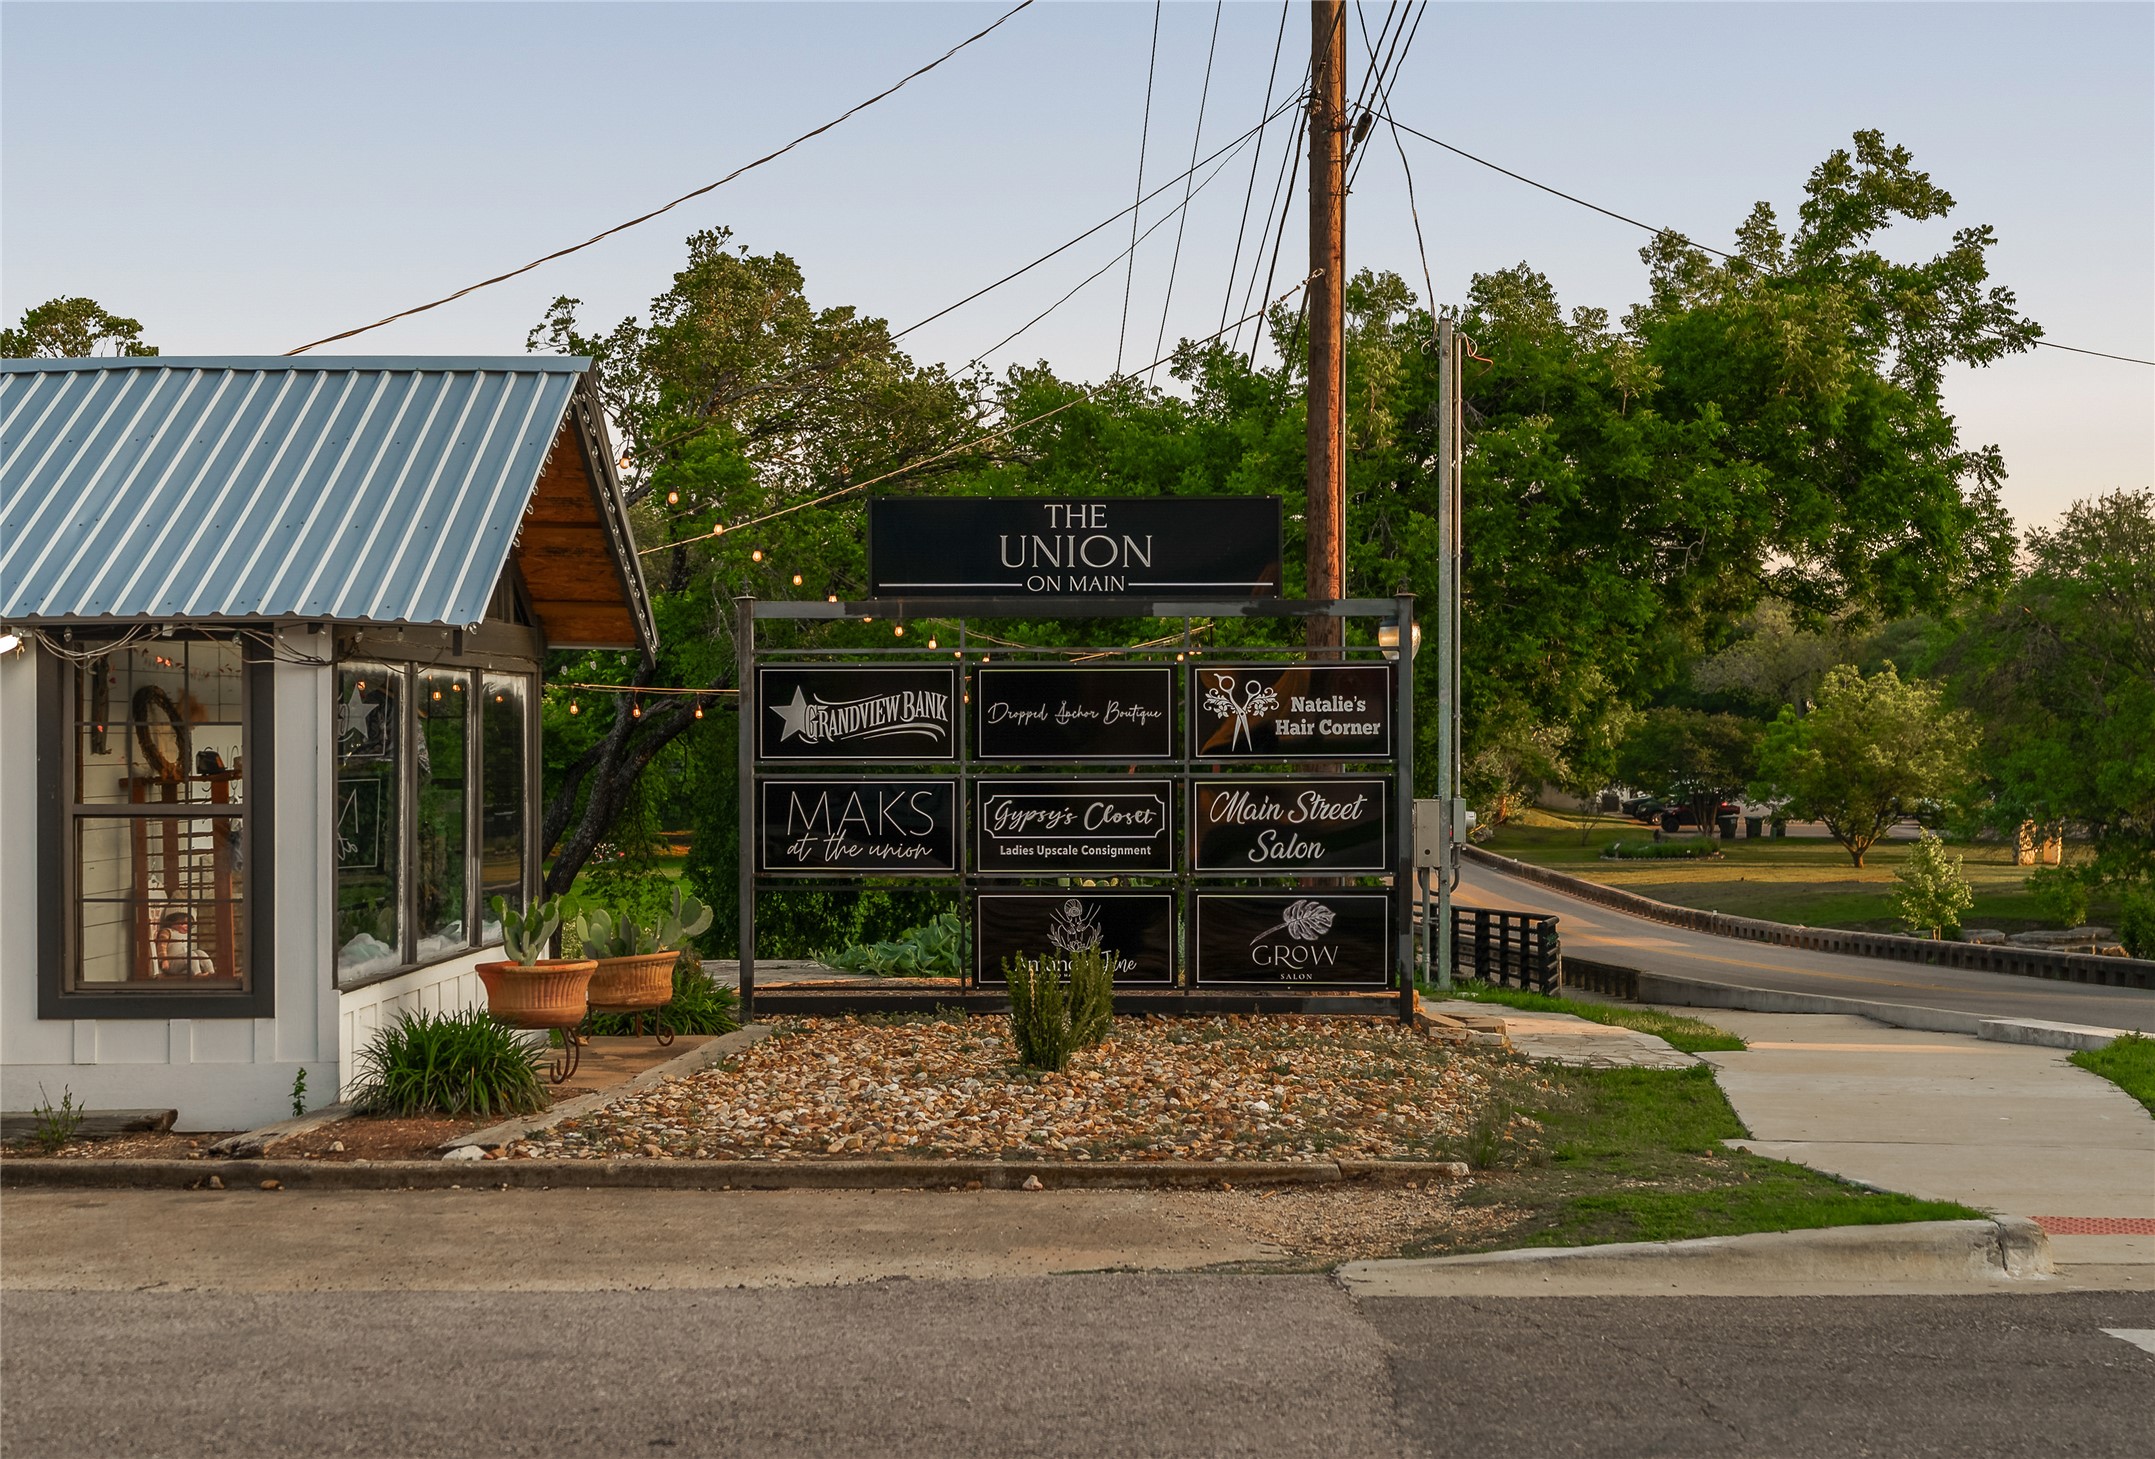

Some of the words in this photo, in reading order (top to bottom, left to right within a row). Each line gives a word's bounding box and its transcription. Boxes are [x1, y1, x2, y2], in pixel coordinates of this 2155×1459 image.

[1044, 503, 1108, 529] THE
[999, 534, 1153, 568] UNION
[1026, 575, 1061, 592] ON
[1069, 575, 1125, 592] MAIN
[804, 693, 901, 742] GRANDVIEW
[899, 690, 949, 723] BANK
[987, 701, 1048, 726] Dropped
[1054, 700, 1099, 725] Anchor
[1103, 700, 1162, 726] Boutique
[1290, 695, 1366, 712] Natalie's
[1275, 718, 1315, 735] Hair
[1318, 719, 1381, 735] Corner
[787, 790, 934, 836] MAKS
[994, 799, 1078, 832] Gypsy's
[1083, 801, 1157, 831] Closet
[1209, 790, 1285, 825] Main
[1287, 790, 1368, 824] Street
[787, 832, 819, 862] at
[823, 829, 864, 862] the
[868, 843, 933, 860] union
[1000, 844, 1034, 856] Ladies
[1036, 844, 1079, 858] Upscale
[1081, 844, 1151, 858] Consignment
[1248, 829, 1326, 863] Salon
[1252, 944, 1339, 970] GROW
